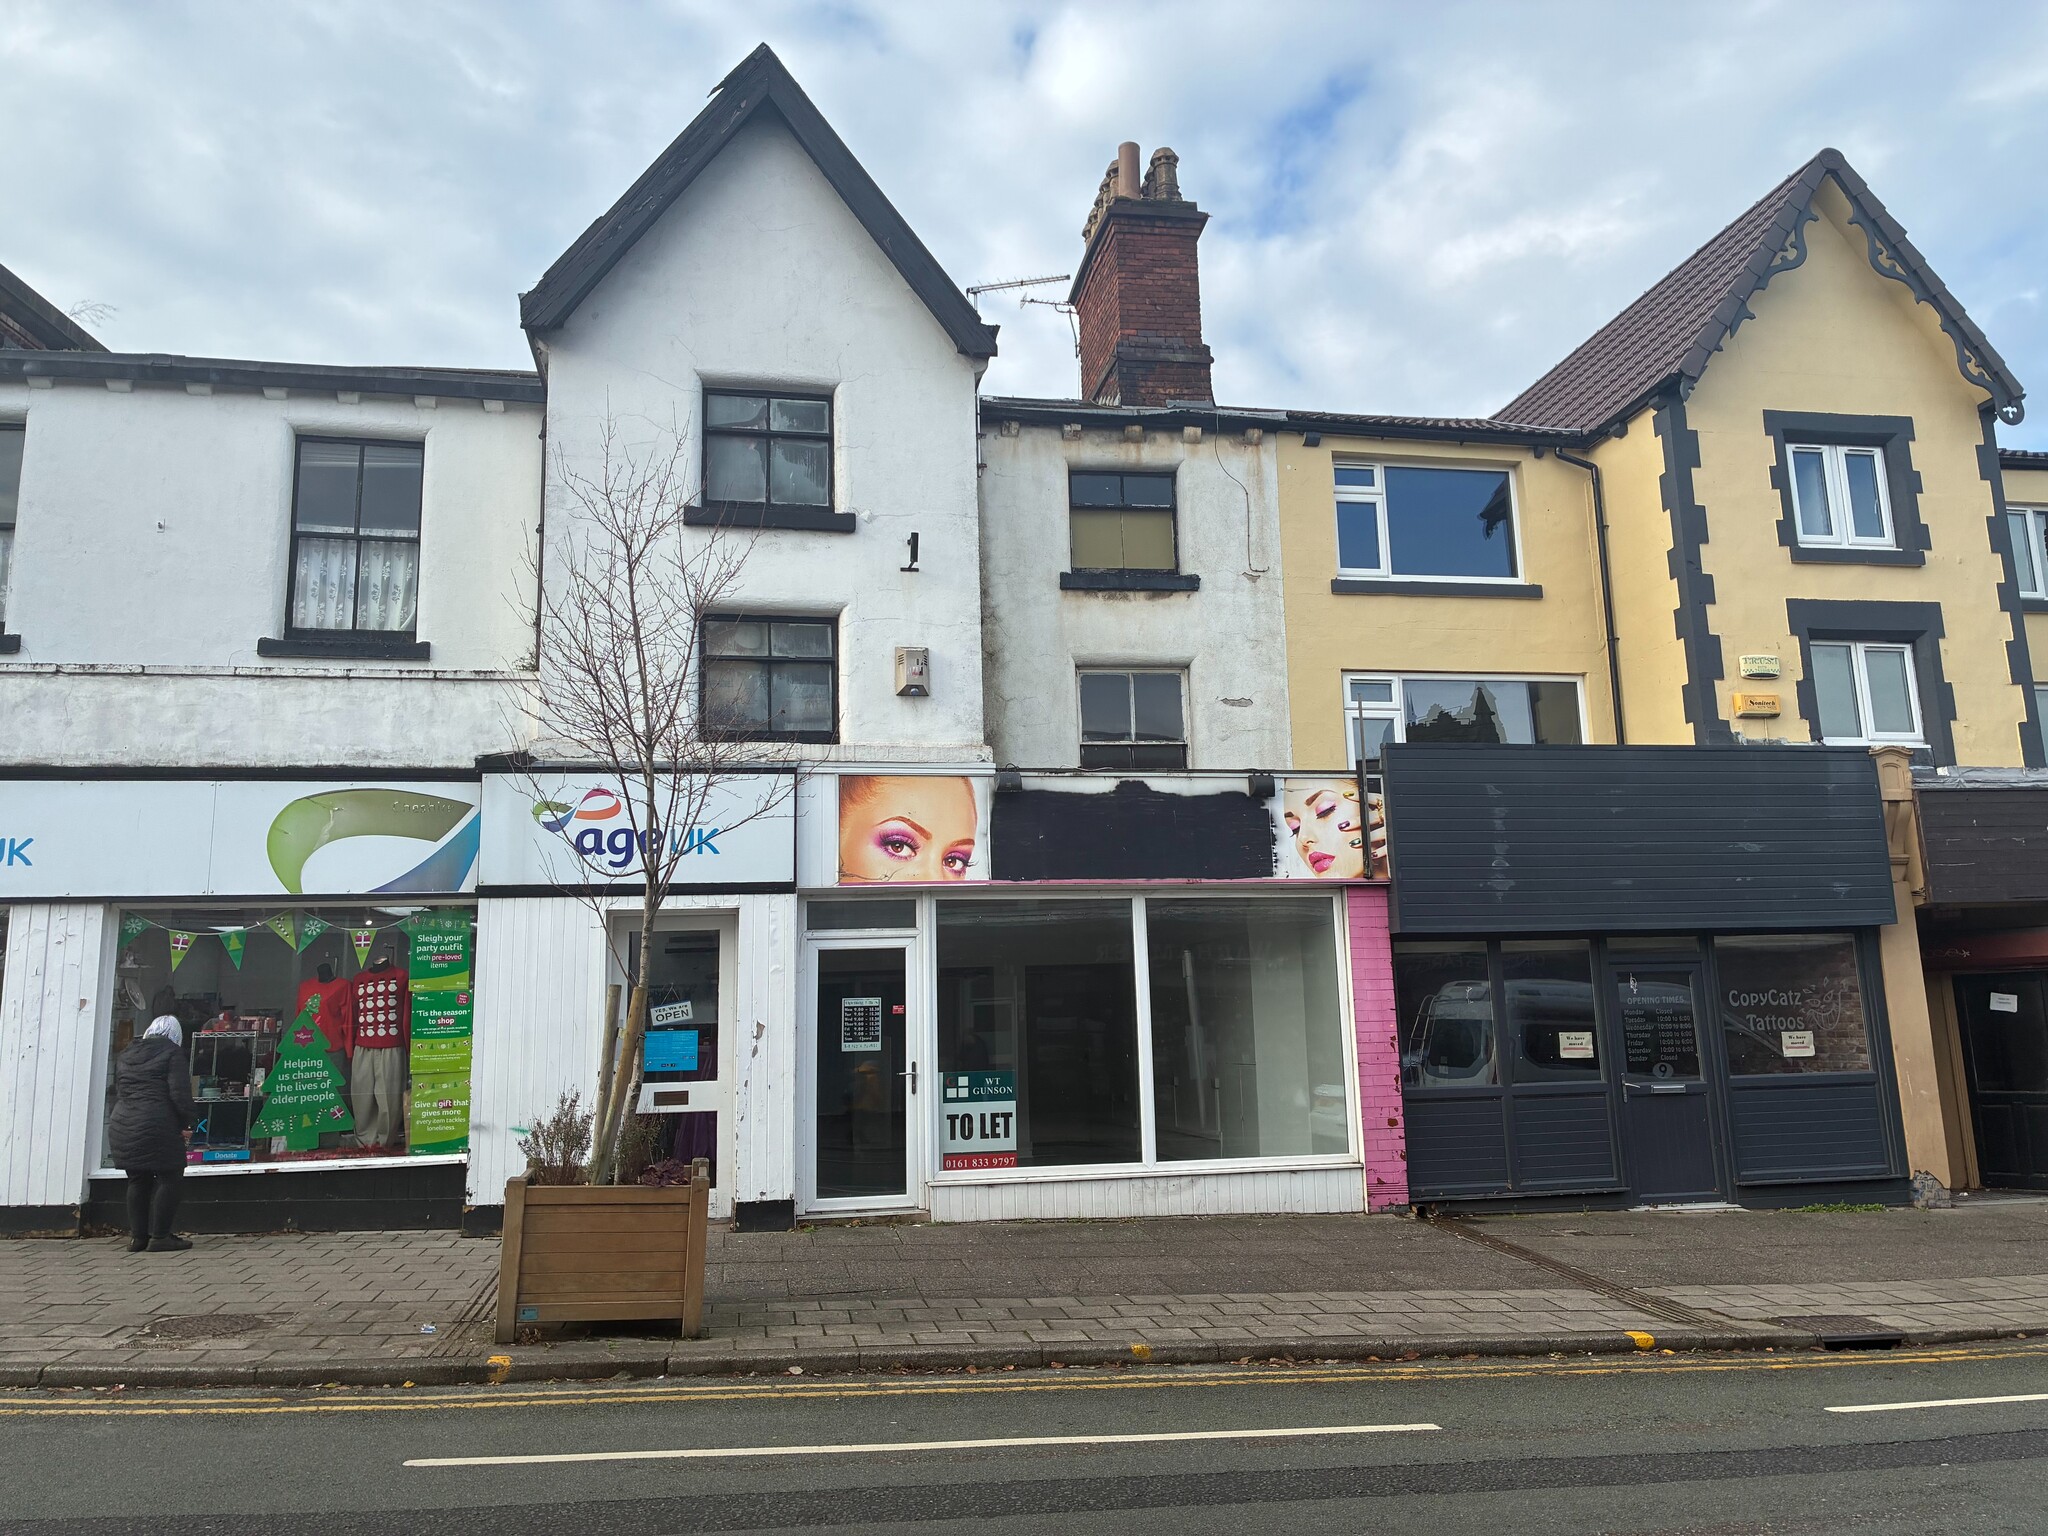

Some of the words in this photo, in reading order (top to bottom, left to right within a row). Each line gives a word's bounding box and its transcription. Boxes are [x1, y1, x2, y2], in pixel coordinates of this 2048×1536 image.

[0, 837, 34, 867] K
[574, 828, 664, 868] age
[670, 828, 721, 855] UK
[417, 934, 443, 943] Sleigh
[444, 935, 463, 943] your
[416, 945, 438, 953] party
[440, 943, 463, 951] outfit
[1627, 996, 1660, 1004] OPENING
[1662, 996, 1684, 1004] TIMES
[1728, 989, 1802, 1007] CopyCatz
[656, 1009, 689, 1022] OPEN
[1746, 1014, 1805, 1031] Tattoos
[284, 1058, 323, 1069] Helping
[278, 1073, 289, 1081] us
[292, 1070, 329, 1080] change
[1658, 1064, 1668, 1078] 9
[276, 1084, 293, 1092] the
[295, 1081, 318, 1091] lives
[320, 1079, 332, 1089] of
[972, 1086, 1013, 1095] GUNSON
[271, 1095, 299, 1105] older
[301, 1091, 335, 1104] people
[438, 1100, 452, 1109] gift
[422, 1110, 440, 1118] gives
[946, 1113, 974, 1141] TO
[980, 1112, 1013, 1139] LET
[946, 1160, 968, 1168] 0161
[972, 1158, 989, 1167] 833
[992, 1157, 1015, 1166] 9797
